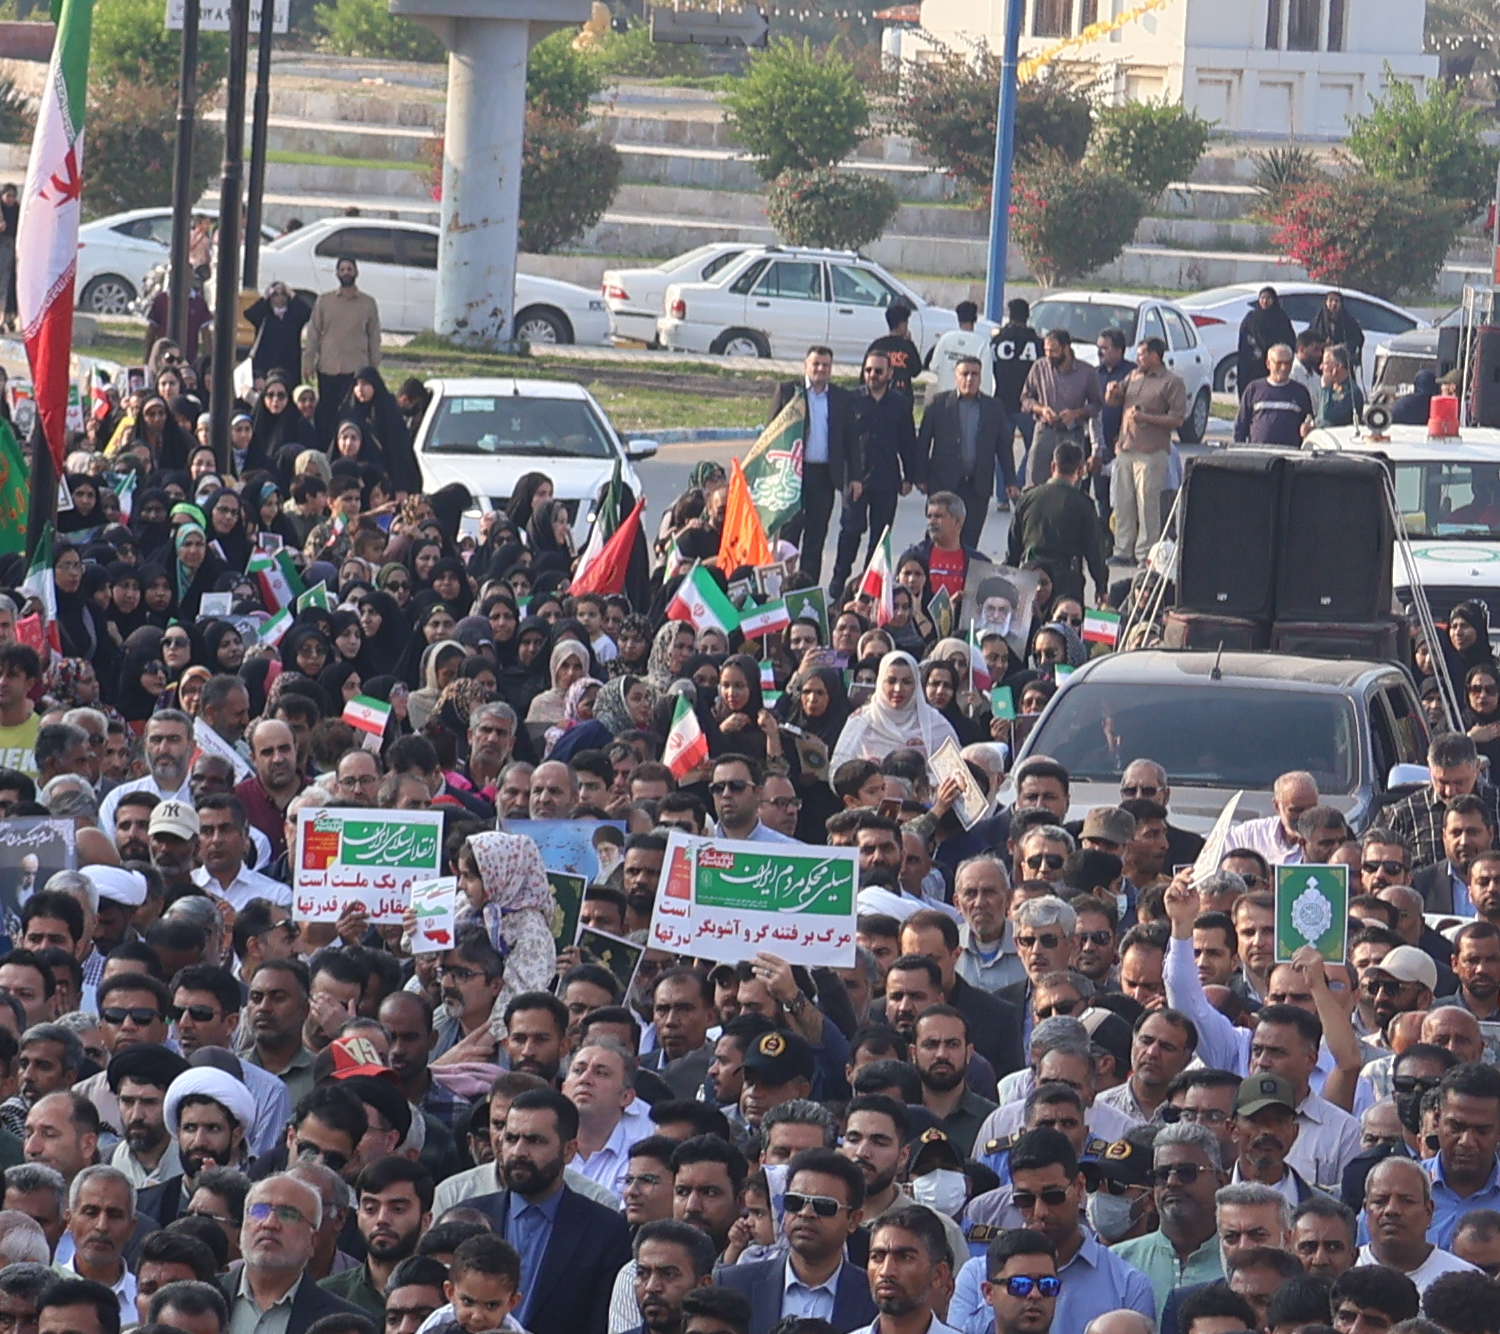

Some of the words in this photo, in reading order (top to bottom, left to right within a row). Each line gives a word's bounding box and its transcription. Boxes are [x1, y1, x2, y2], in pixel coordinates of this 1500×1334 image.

[298, 872, 328, 888] است
[373, 873, 397, 895] یک
[695, 919, 741, 940] آشوبگر
[744, 931, 751, 942] و
[752, 924, 769, 943] گر
[771, 923, 799, 941] فتنه
[800, 929, 814, 946] بر
[817, 928, 851, 948] مرگ
